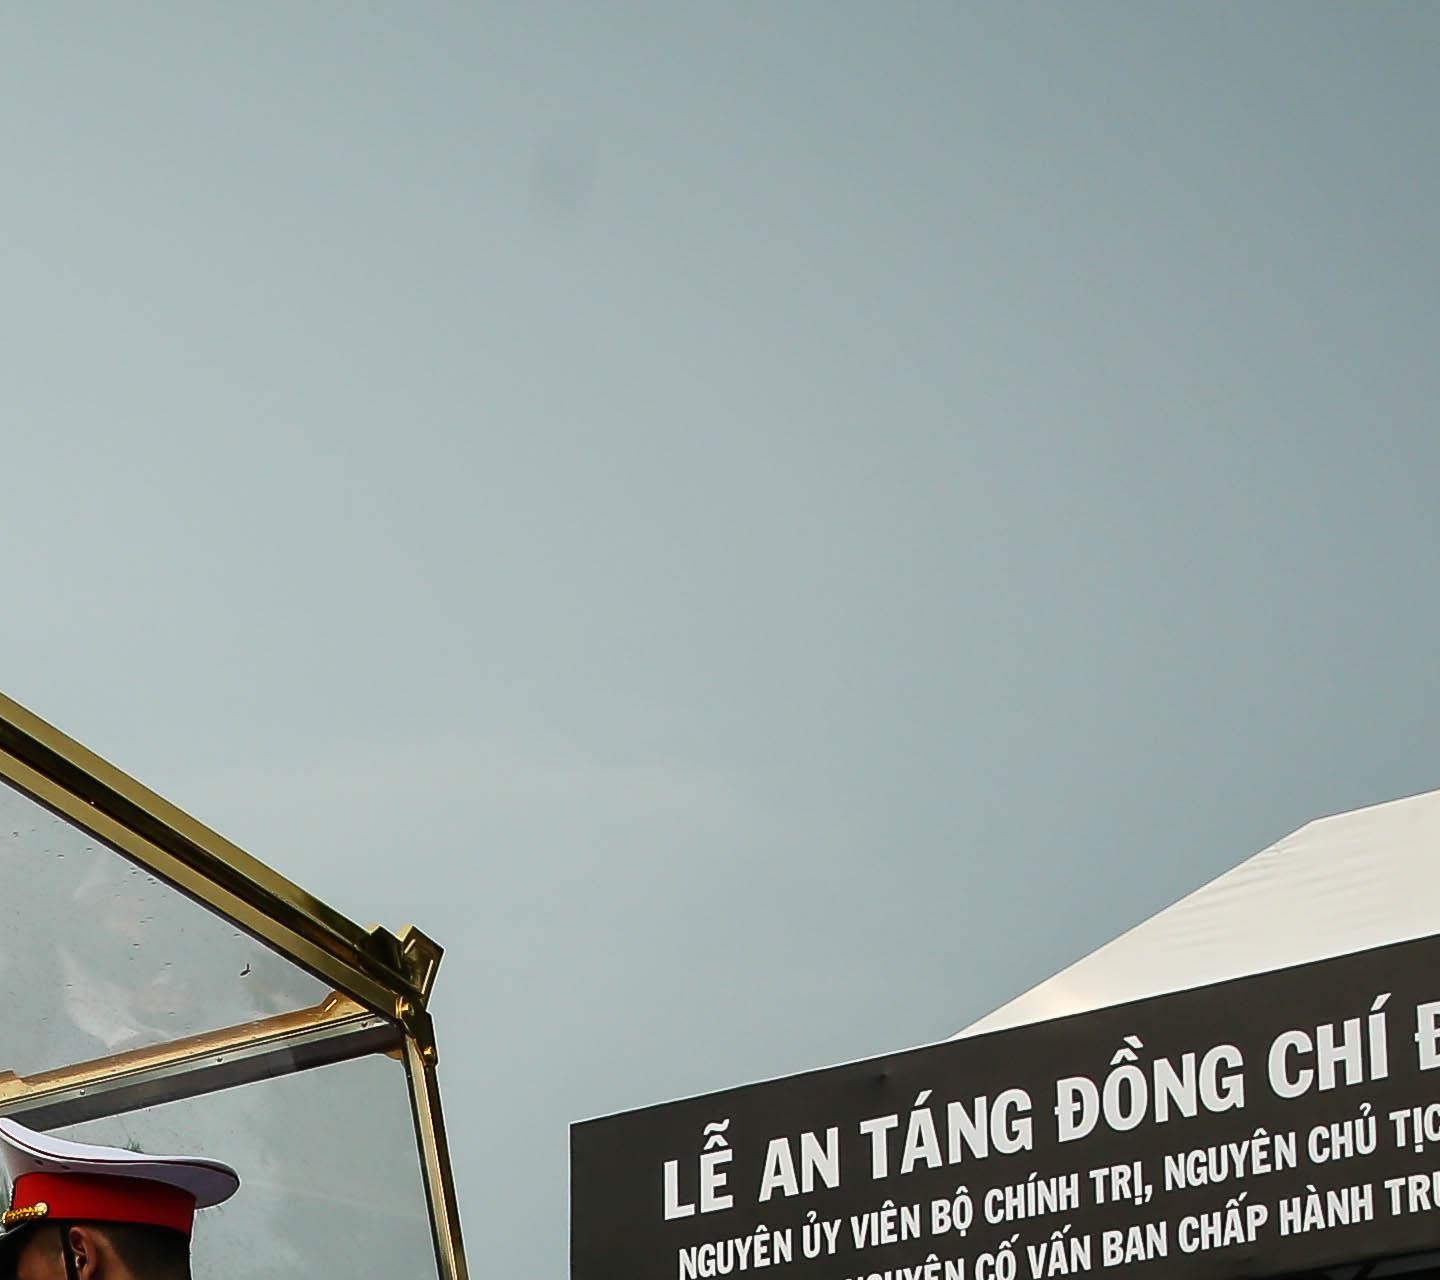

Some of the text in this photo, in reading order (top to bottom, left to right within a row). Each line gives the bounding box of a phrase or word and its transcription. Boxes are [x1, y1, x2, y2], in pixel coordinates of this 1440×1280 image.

[663, 1118, 734, 1221] LỄ
[758, 1126, 840, 1203] AN
[859, 1088, 1033, 1180] TÁNG
[1053, 1035, 1245, 1143] ĐỒNG
[1267, 992, 1392, 1099] CHÍ
[802, 1210, 842, 1259] ỦY
[850, 1199, 921, 1249] VIÊN
[931, 1185, 974, 1237] BỘ
[984, 1171, 1080, 1224] CHÍNH
[1088, 1160, 1153, 1206] TRỊ,
[1164, 1127, 1297, 1192] NGUYÊN
[1307, 1102, 1377, 1164] CHỦ
[1026, 1223, 1092, 1280] VẤN
[1102, 1220, 1168, 1267] BAN
[1178, 1191, 1269, 1253] CHẤP
[1279, 1183, 1374, 1236] HÀNH
